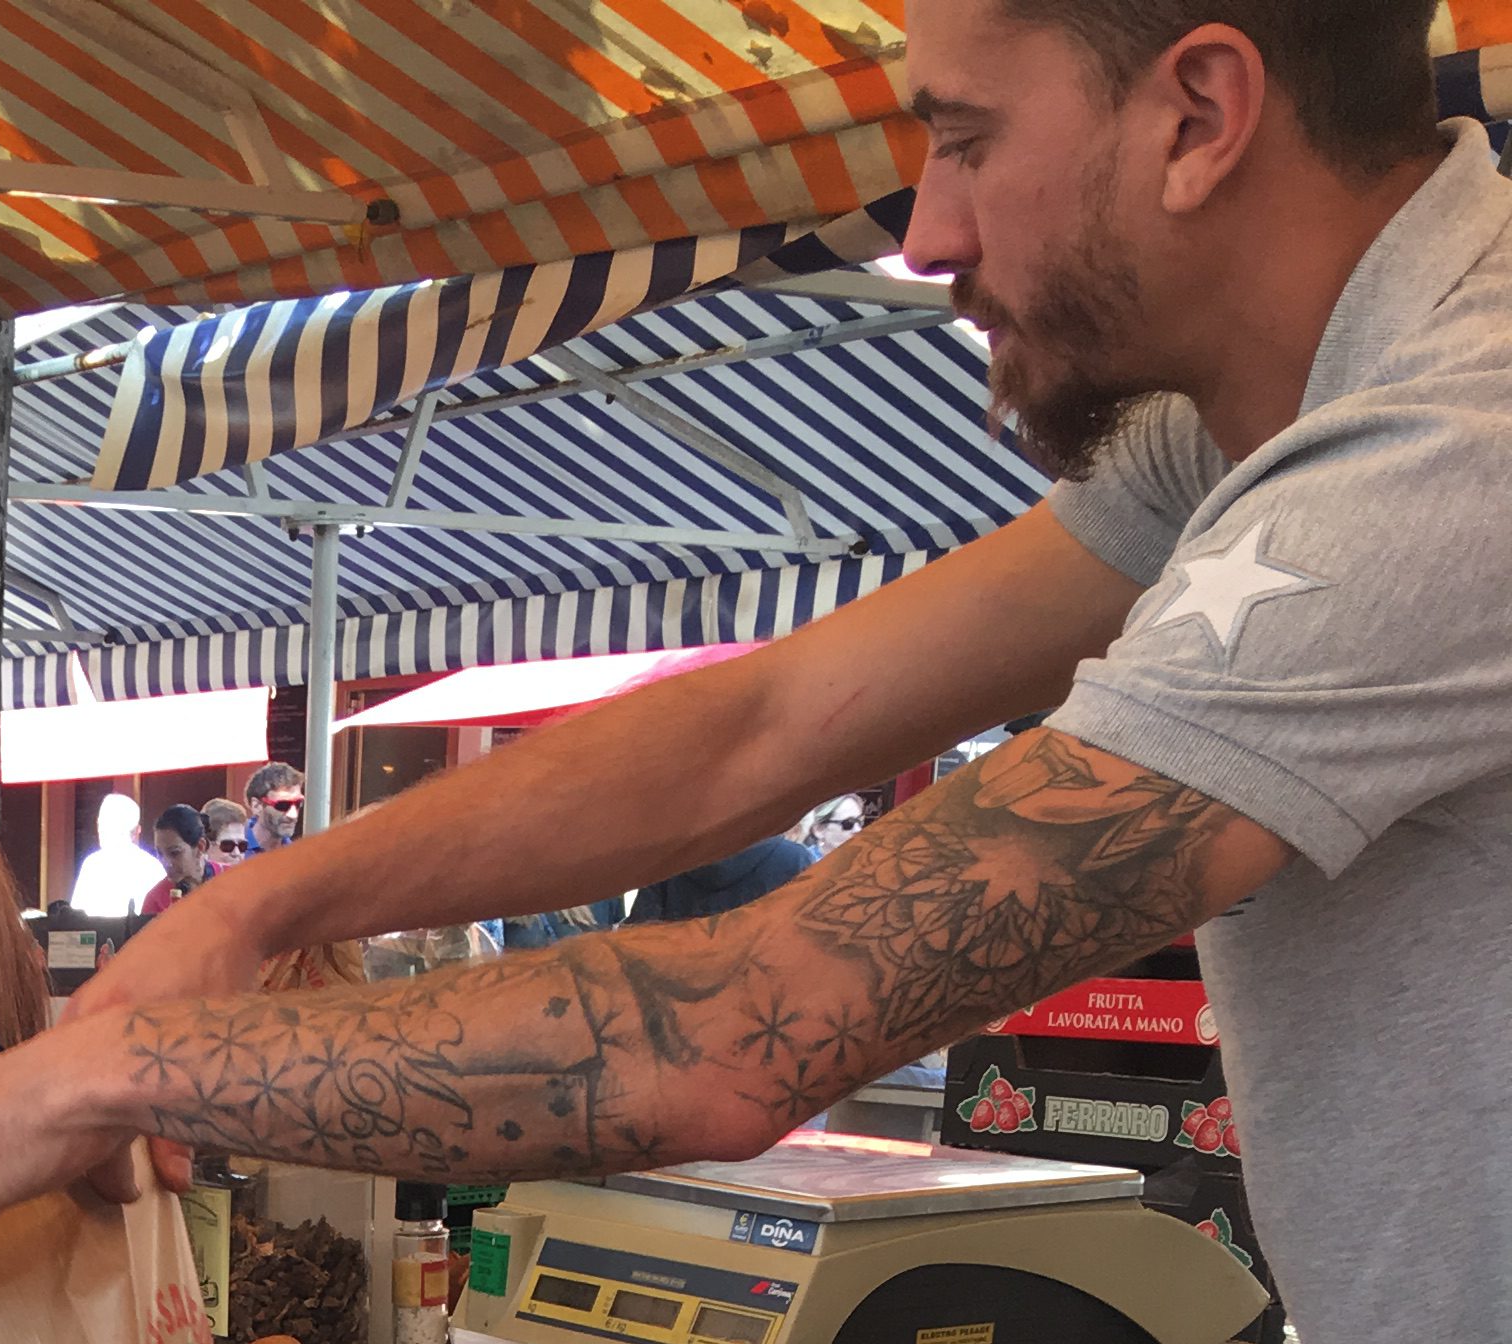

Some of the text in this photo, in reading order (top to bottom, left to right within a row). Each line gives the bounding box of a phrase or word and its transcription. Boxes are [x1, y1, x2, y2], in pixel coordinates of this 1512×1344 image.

[1088, 992, 1144, 1011] FRUTTA
[1048, 1011, 1184, 1034] LAVORATA A MANO
[1044, 1095, 1169, 1142] FERRARO
[760, 1223, 804, 1243] DINA
